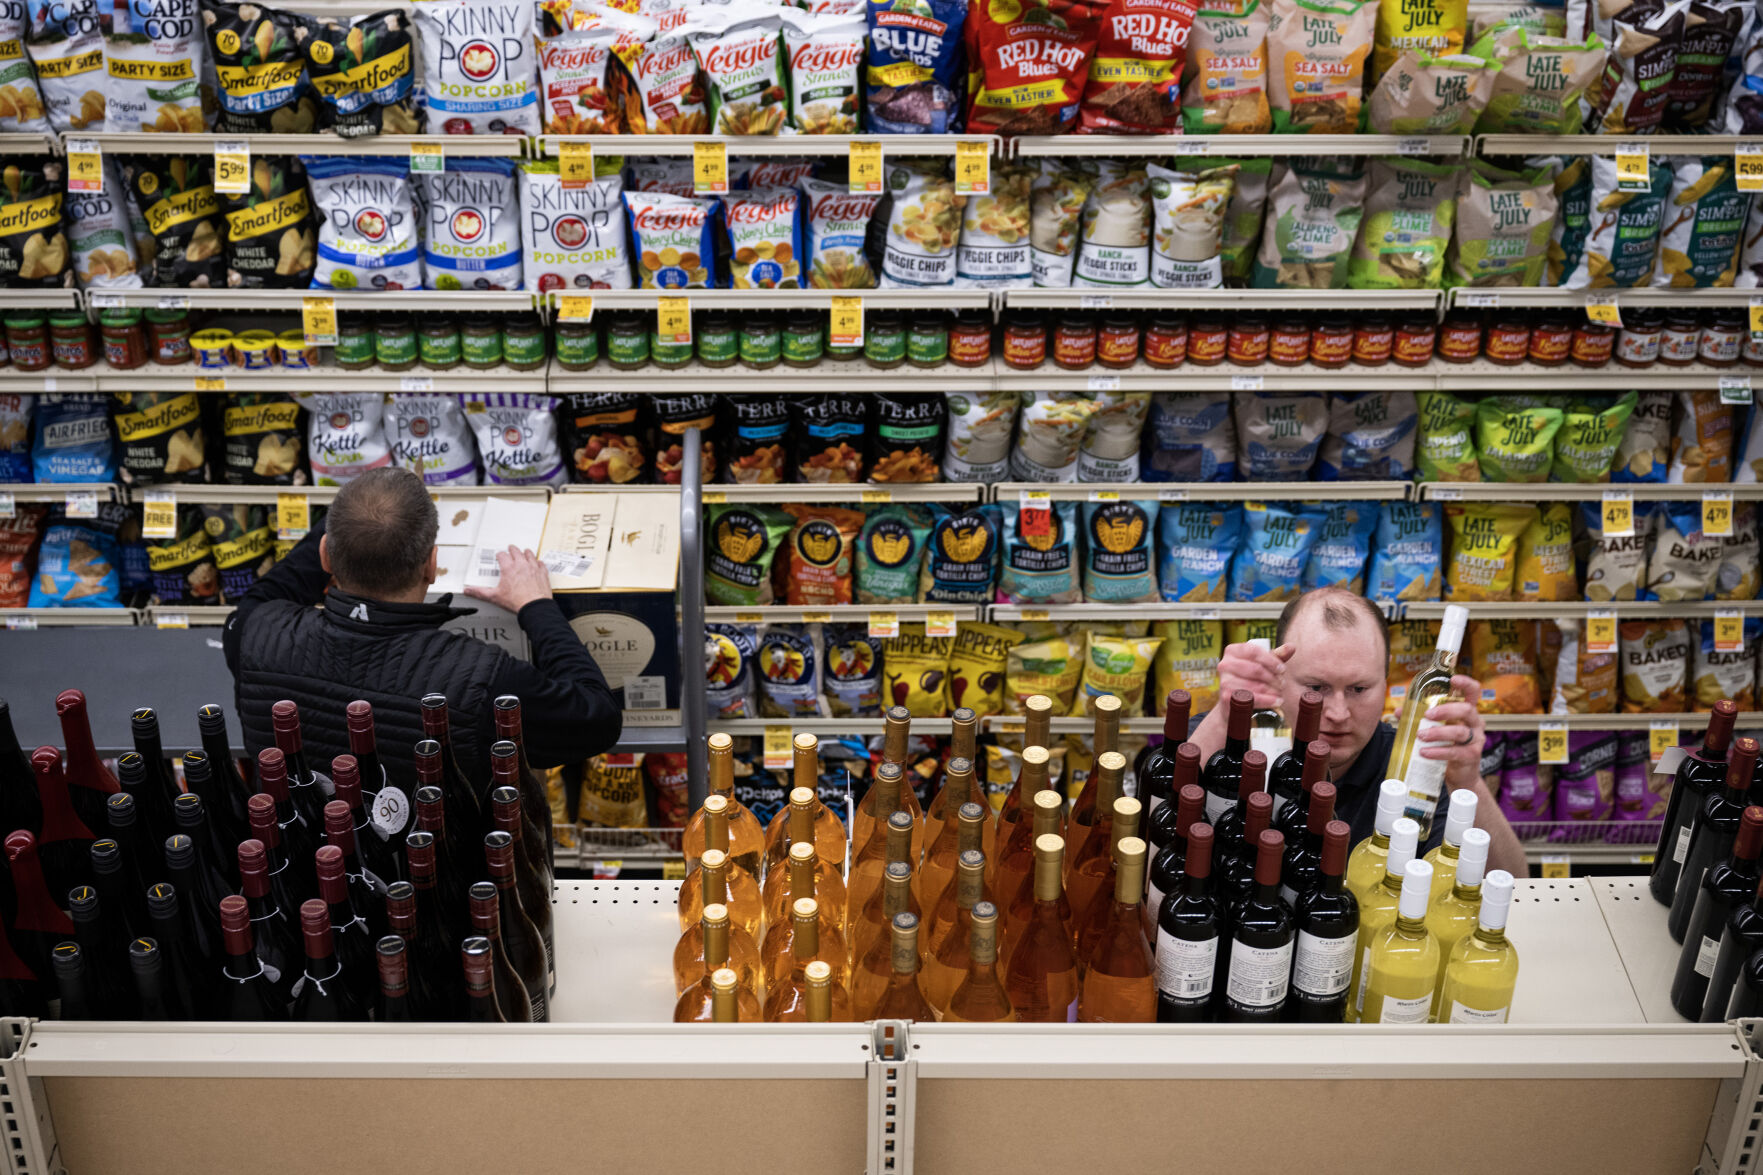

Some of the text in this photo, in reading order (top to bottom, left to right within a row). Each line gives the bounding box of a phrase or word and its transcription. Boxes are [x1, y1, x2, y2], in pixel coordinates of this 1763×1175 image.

[143, 19, 193, 39] COD
[1303, 15, 1337, 32] LATE
[1403, 8, 1444, 32] JULY
[871, 27, 943, 57] BLUE
[1214, 24, 1248, 43] JULY
[1306, 29, 1343, 48] JULY
[1391, 36, 1449, 48] MEXICAN
[997, 39, 1085, 71] RED HOT
[1131, 37, 1173, 55] Blues
[439, 37, 523, 82] POP
[540, 46, 604, 71] Veggie
[696, 38, 777, 73] Veggie
[787, 41, 862, 72] Veggie
[1206, 57, 1260, 69] SEA SALT
[1527, 54, 1563, 75] LATE
[112, 61, 187, 76] PARTY SIZE
[1018, 62, 1059, 77] Blues
[1097, 67, 1122, 77] EVEN
[1294, 62, 1350, 74] SEA SALT
[440, 81, 527, 98] POPCORN
[1436, 75, 1468, 95] LATE
[1528, 74, 1569, 91] JULY
[445, 99, 524, 111] SHARING SIZE
[987, 90, 1055, 104] EVEN TASTIER!
[1398, 180, 1438, 200] JULY
[71, 199, 112, 221] COD
[724, 194, 798, 227] Veggie
[1490, 193, 1522, 213] LATE
[634, 206, 706, 230] Veggie
[1400, 218, 1430, 232] LIME
[1494, 207, 1532, 231] JULY
[531, 211, 608, 251] POP
[236, 247, 266, 258] WHITE
[432, 241, 507, 258] POPCORN
[533, 246, 617, 264] POPCORN
[964, 250, 1026, 263] VEGGIE CHIPS
[1098, 249, 1122, 258] RANCH
[233, 258, 275, 270] CHEDDAR
[887, 252, 947, 272] VEGGIE CHIPS
[1084, 256, 1138, 272] VEGGIE STICKS
[1158, 269, 1214, 282] VEGGIE STICKS
[803, 399, 867, 417] TERRA
[878, 399, 944, 419] TERRA
[122, 403, 195, 435] Smartfood
[227, 411, 293, 430] Smartfood
[318, 411, 364, 432] POP
[398, 415, 440, 439] POP
[48, 420, 109, 441] AIRFRIED
[490, 425, 532, 447] POP
[1501, 426, 1541, 447] JULY
[128, 447, 155, 457] WHITE
[394, 438, 449, 460] Kettle
[486, 450, 541, 469] Kettle
[49, 464, 105, 475] VINEGAR
[1107, 466, 1133, 478] STICKS
[145, 513, 173, 525] FREE
[1103, 504, 1135, 518] SIETE
[1178, 508, 1210, 527] LATE
[951, 517, 980, 528] SIETE
[1263, 515, 1295, 532] LATE
[1394, 517, 1430, 540] JULY
[1463, 516, 1496, 535] LATE
[1181, 523, 1217, 544] JULY
[1263, 530, 1301, 550] JULY
[1465, 533, 1503, 551] JULY
[1021, 550, 1060, 560] GRAIN FREE
[1172, 545, 1218, 560] GARDEN
[1387, 541, 1432, 555] GARDEN
[943, 562, 983, 571] GRAIN FREE
[1046, 555, 1068, 567] CHIPS
[1095, 560, 1147, 571] TORTILLA CHIPS
[1100, 553, 1141, 563] GRAIN FREE
[1182, 558, 1225, 572] RANCH
[1455, 552, 1505, 570] MEXICAN
[1260, 562, 1302, 578] RANCH
[452, 627, 512, 641] OHR
[586, 640, 638, 652] OGLE
[1183, 634, 1214, 655] JULY
[1629, 644, 1689, 665] BAKED
